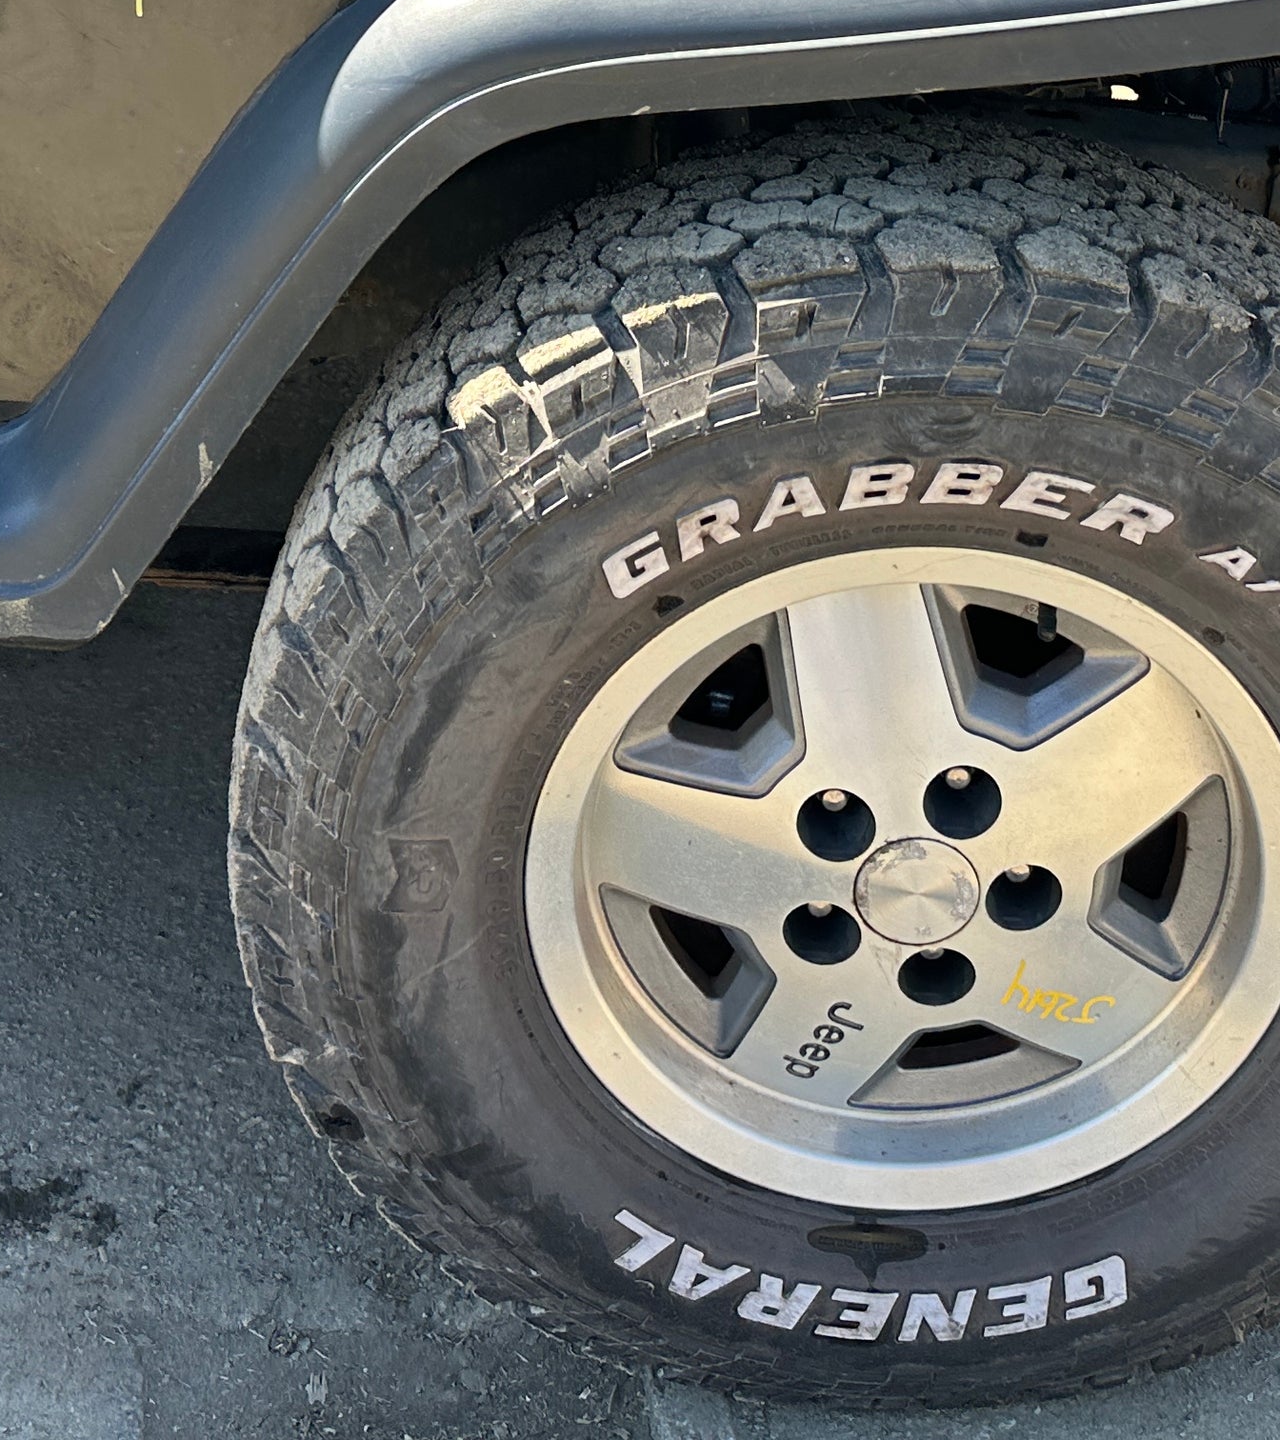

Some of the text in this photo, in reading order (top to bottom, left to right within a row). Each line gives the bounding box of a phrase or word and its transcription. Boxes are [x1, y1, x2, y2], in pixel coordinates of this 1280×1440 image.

[602, 462, 1175, 599] GRABBER
[782, 1001, 864, 1079] Jeep
[1001, 959, 1117, 1025] J2614
[614, 1208, 1129, 1342] GENERAL
